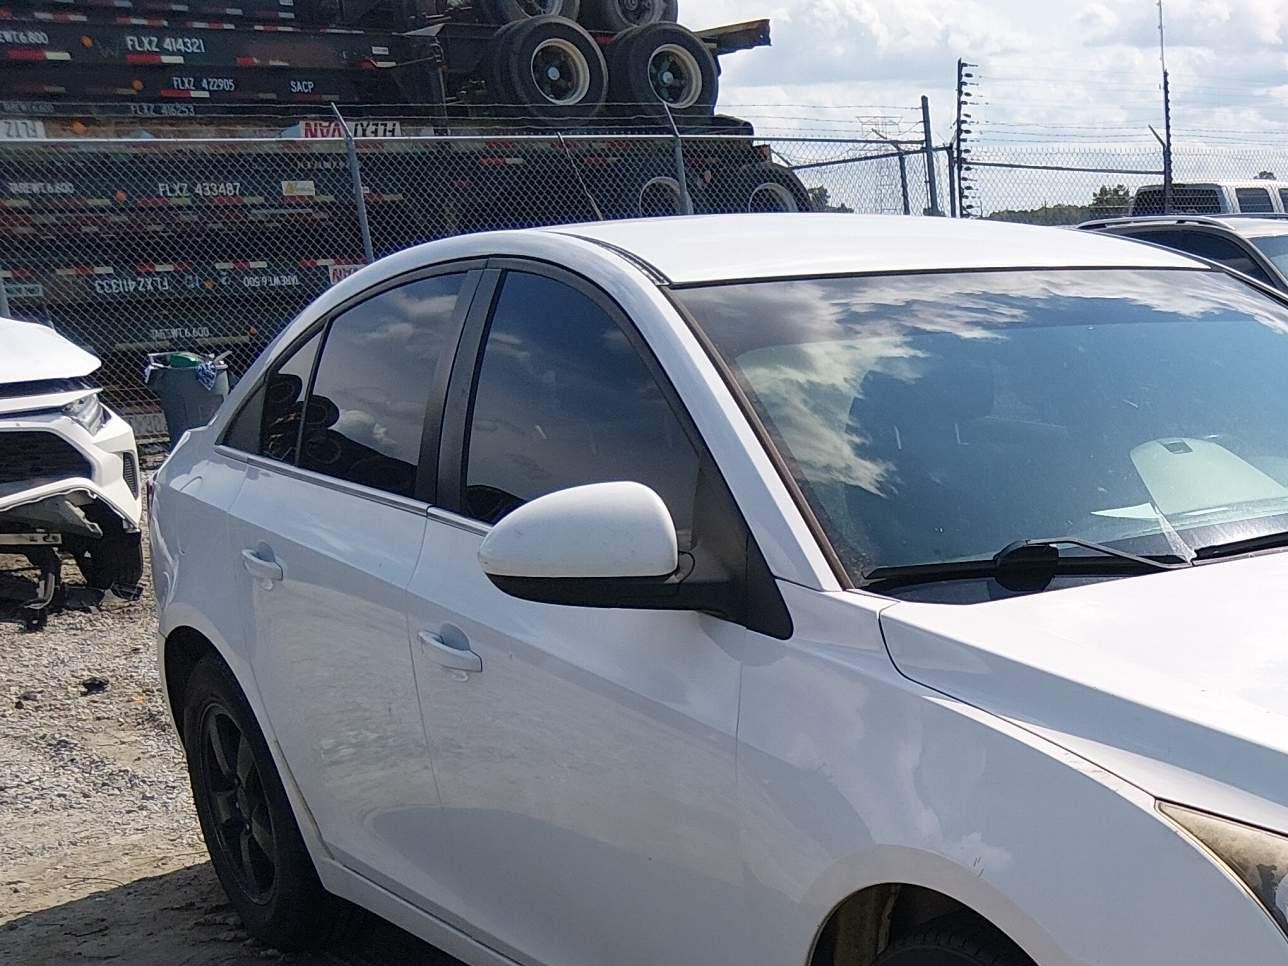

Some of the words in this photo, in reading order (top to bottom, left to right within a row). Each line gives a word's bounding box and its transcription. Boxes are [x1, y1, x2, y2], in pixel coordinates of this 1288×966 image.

[126, 36, 160, 51] FLXZ
[163, 37, 206, 53] 414321
[172, 77, 196, 90] FLXZ
[201, 78, 235, 91] 422905
[290, 80, 314, 93] SACP
[304, 121, 343, 138] VAN
[158, 183, 188, 196] FLXZ
[194, 182, 240, 195] 433487
[95, 278, 137, 293] 411333
[137, 277, 169, 291] FLXZ
